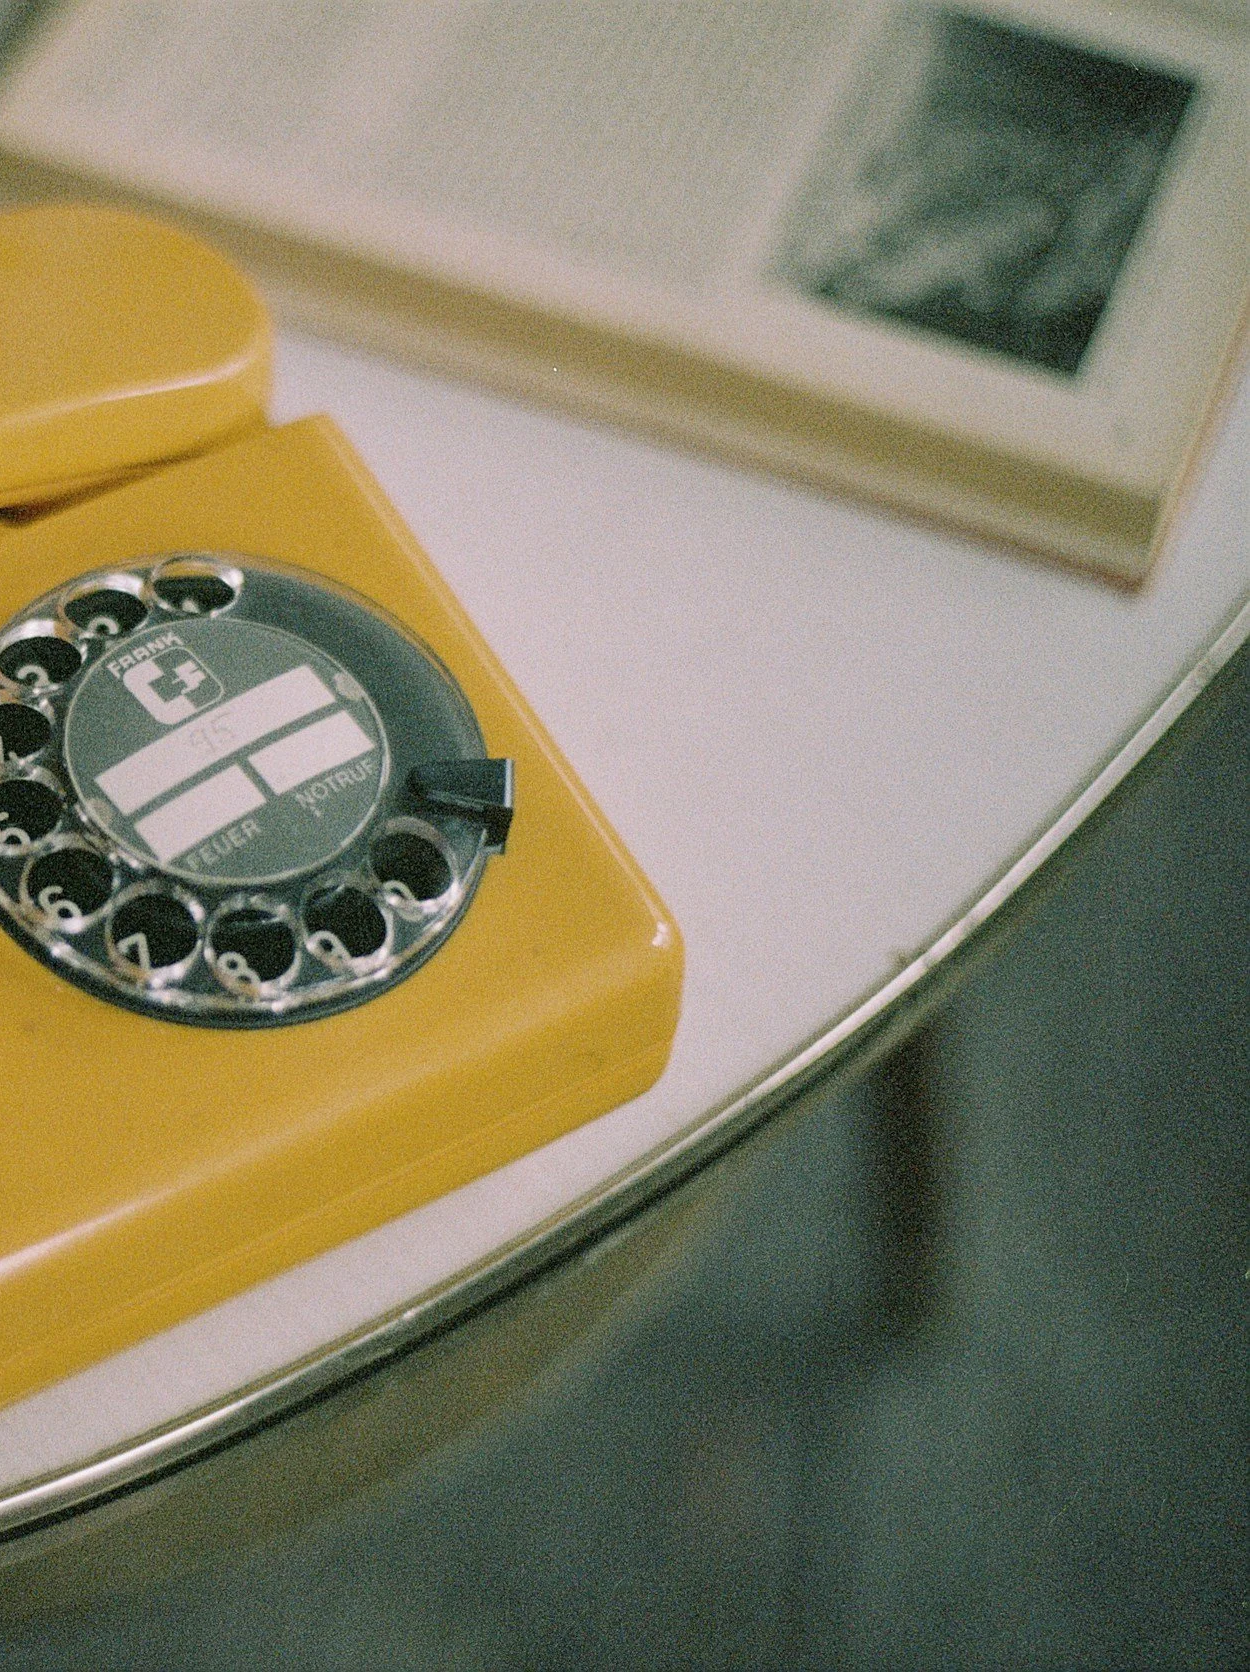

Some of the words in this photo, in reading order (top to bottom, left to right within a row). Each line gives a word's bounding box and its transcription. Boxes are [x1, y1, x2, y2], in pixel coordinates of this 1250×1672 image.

[106, 631, 184, 680] FRANK
[296, 757, 375, 812] NOTRUF
[186, 818, 263, 873] FEUER
[37, 886, 83, 933] 6
[116, 933, 150, 973] 7
[216, 951, 263, 998] 8
[305, 930, 353, 973] 9
